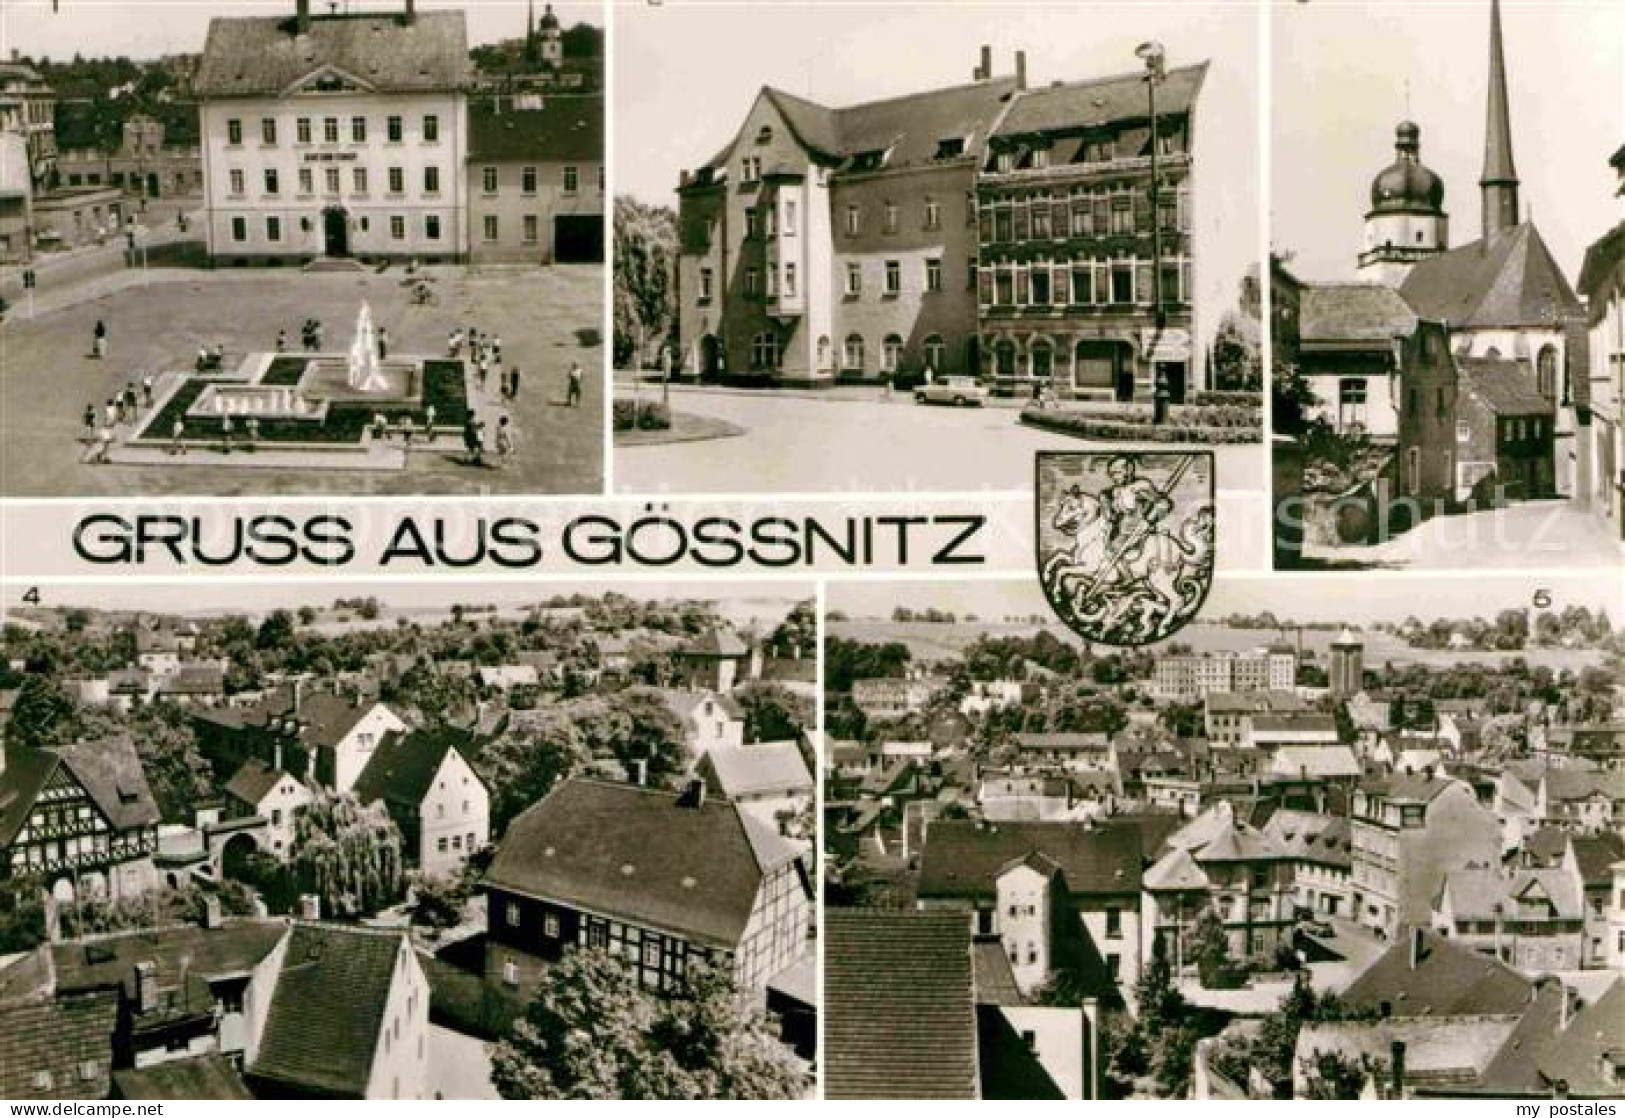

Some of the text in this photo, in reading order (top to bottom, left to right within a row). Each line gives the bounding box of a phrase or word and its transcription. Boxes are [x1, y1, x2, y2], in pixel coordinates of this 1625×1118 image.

[73, 514, 356, 566] GRUSS
[379, 516, 543, 568] AUS
[561, 503, 986, 567] GÖSSNITZ
[22, 586, 41, 605] 4
[1534, 589, 1552, 609] 5
